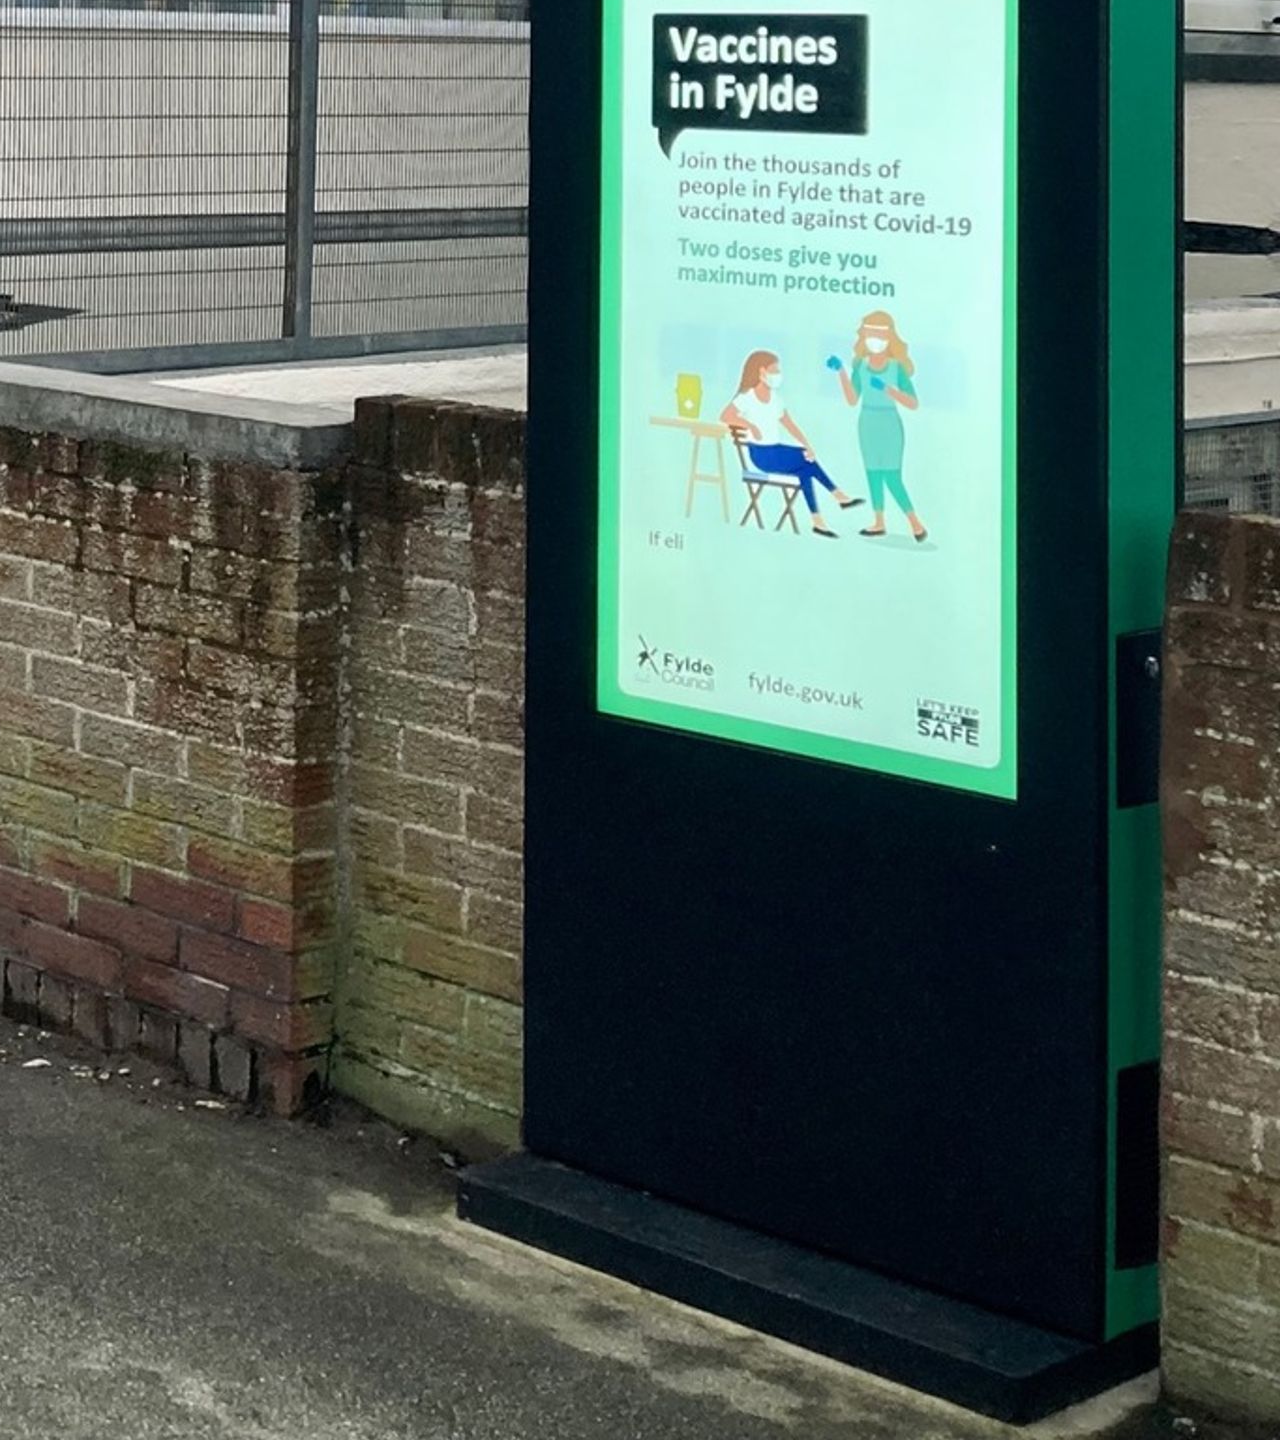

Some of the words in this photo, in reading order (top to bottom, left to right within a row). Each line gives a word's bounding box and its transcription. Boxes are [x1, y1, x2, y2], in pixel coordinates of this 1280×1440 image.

[668, 25, 838, 66] Vaccines
[668, 73, 704, 109] in
[715, 73, 819, 119] Fylde
[678, 151, 718, 170] Join
[723, 153, 757, 172] the
[762, 154, 871, 177] thousands
[877, 159, 902, 179] of
[678, 179, 746, 201] people
[752, 180, 771, 199] in
[777, 181, 833, 206] Fylde
[838, 184, 883, 205] that
[889, 188, 926, 207] are
[678, 203, 785, 226] vaccinated
[791, 209, 868, 233] against
[874, 212, 972, 236] Covid-19
[678, 238, 720, 258] Two
[725, 240, 783, 262] doses
[788, 245, 831, 268] give
[837, 253, 878, 271] you
[677, 265, 778, 289] maximum
[783, 267, 896, 297] protection
[663, 533, 684, 551] eli
[663, 652, 714, 676] Fylde
[661, 669, 715, 691] Council
[748, 671, 864, 711] fylde.gov.uk
[917, 719, 980, 747] SAFE
